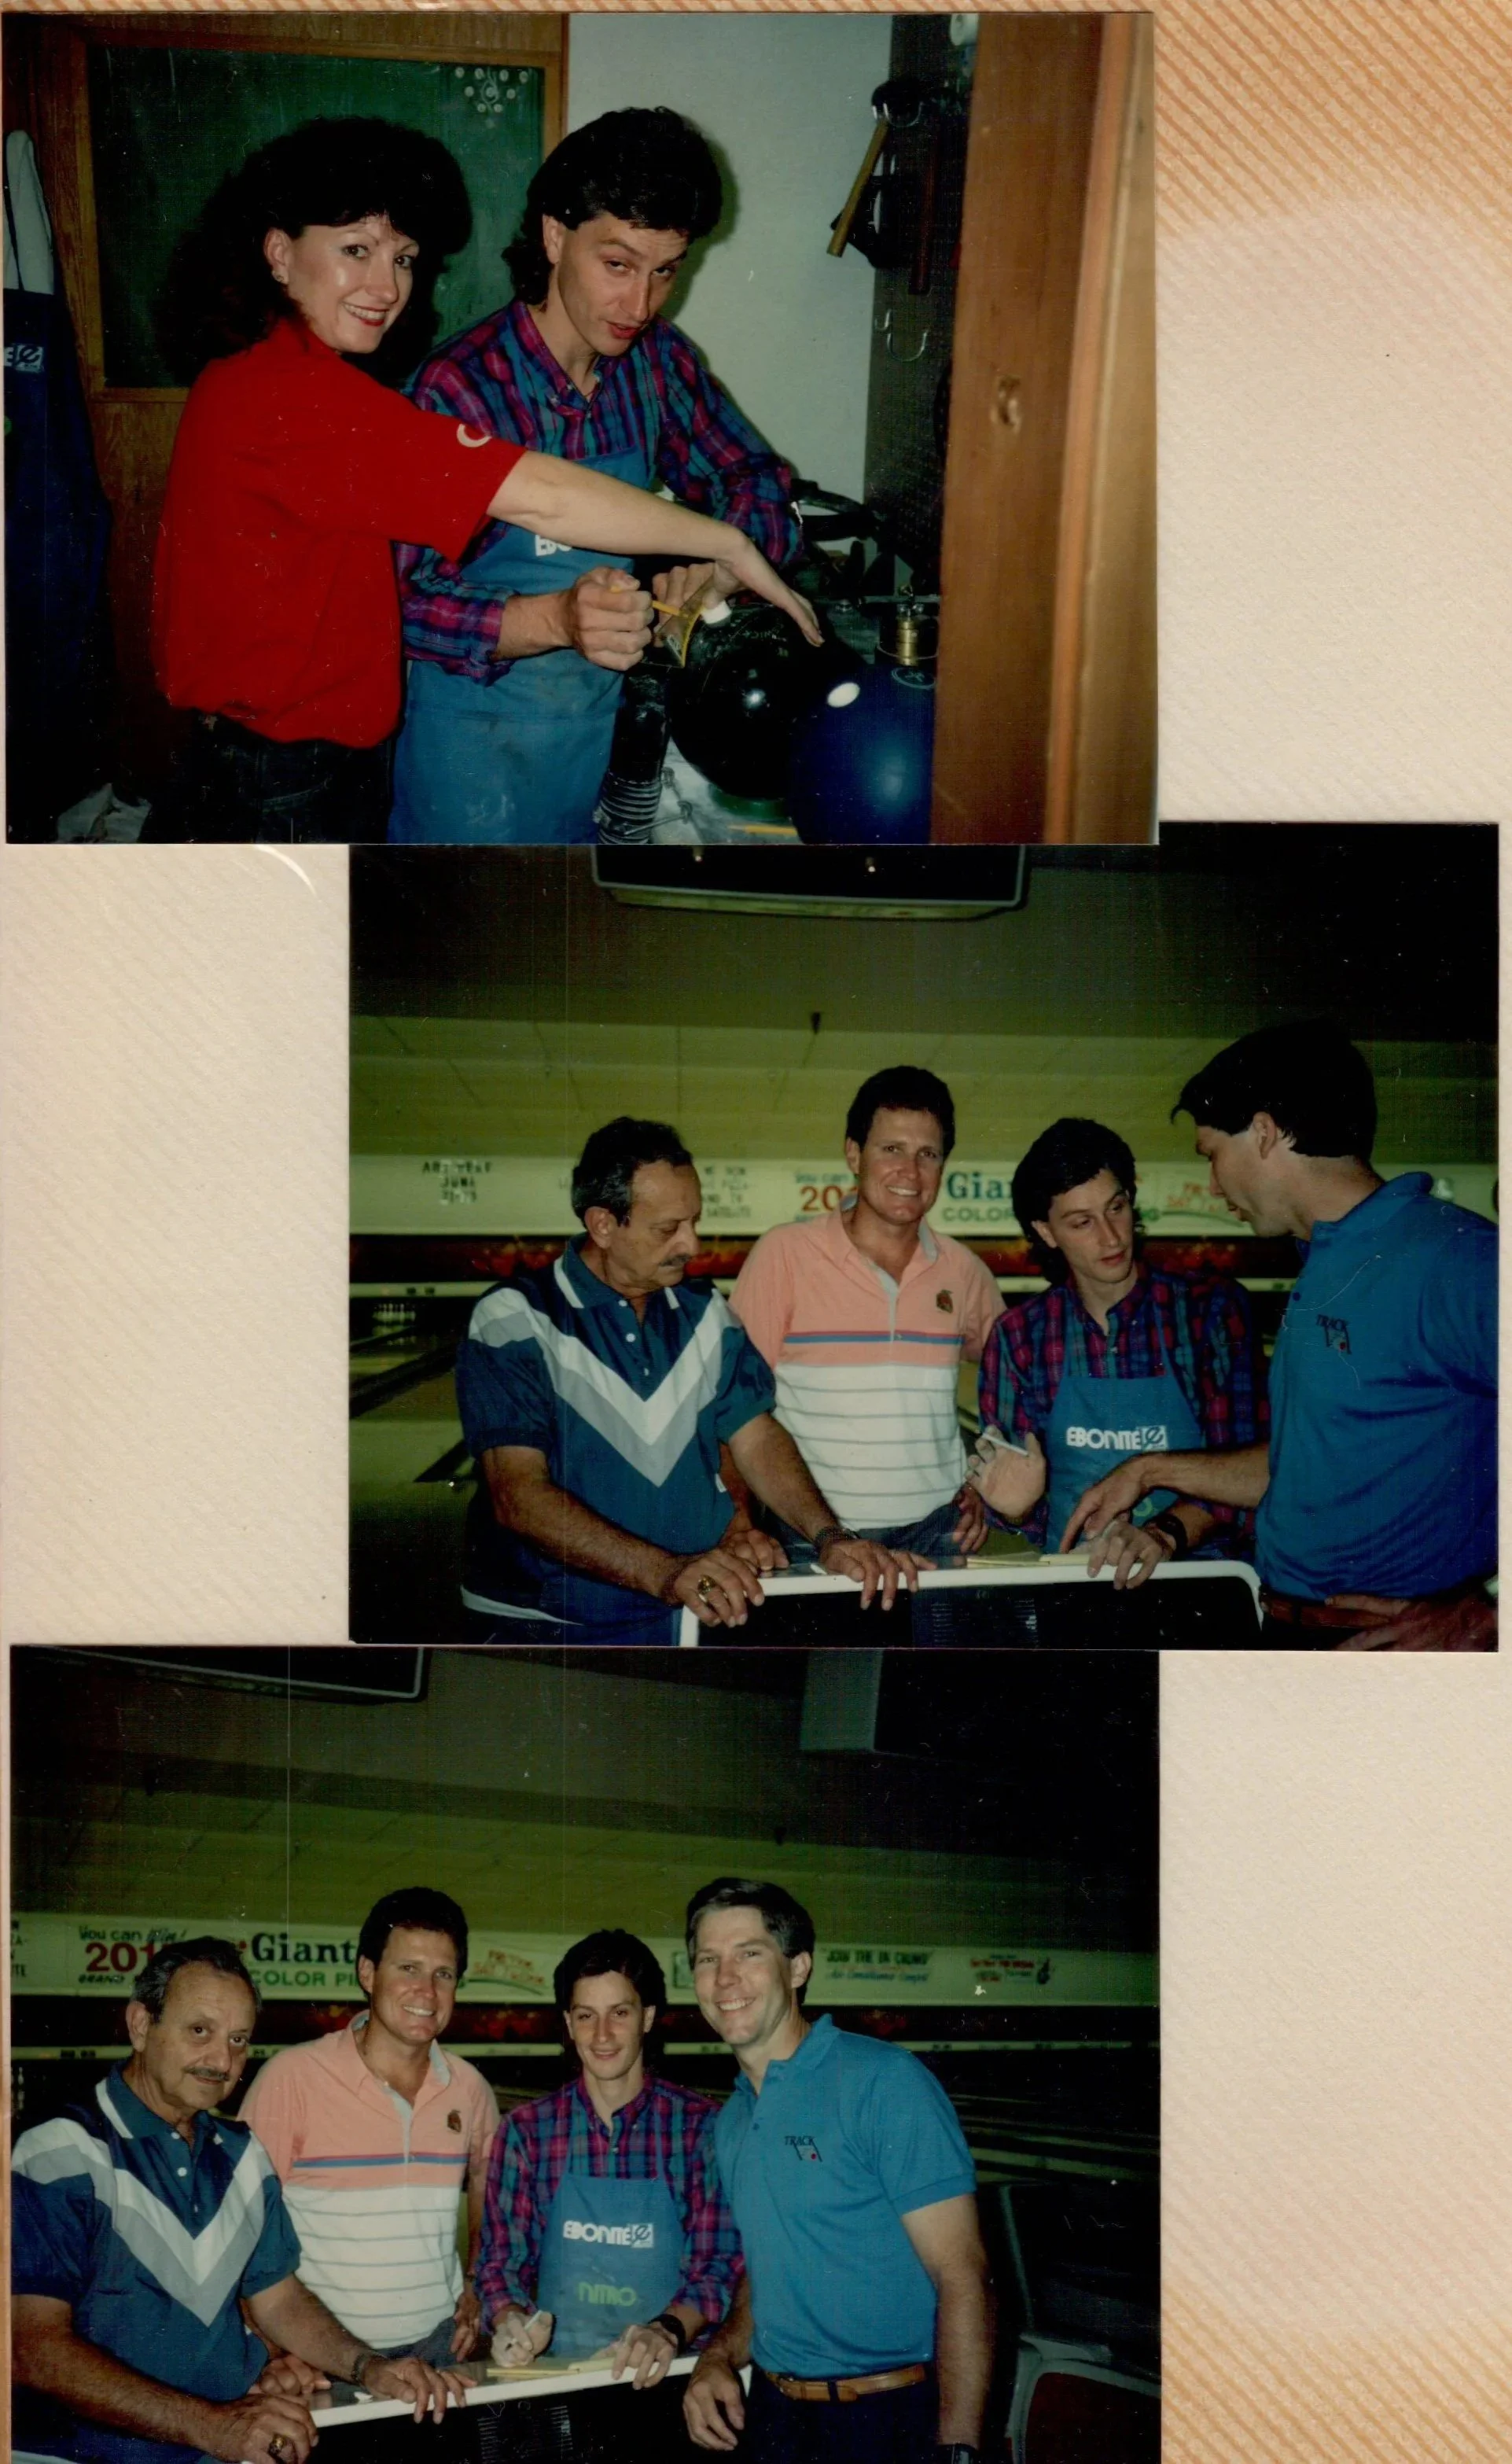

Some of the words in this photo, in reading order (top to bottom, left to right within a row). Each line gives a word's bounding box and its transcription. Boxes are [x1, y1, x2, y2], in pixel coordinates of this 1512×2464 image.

[800, 1184, 859, 1212] 20
[946, 1170, 1014, 1199] Gia
[84, 1941, 170, 1972] 201
[251, 1932, 359, 1965] Giant
[248, 1969, 324, 1987] COLOR
[579, 2282, 638, 2307] NITRO
